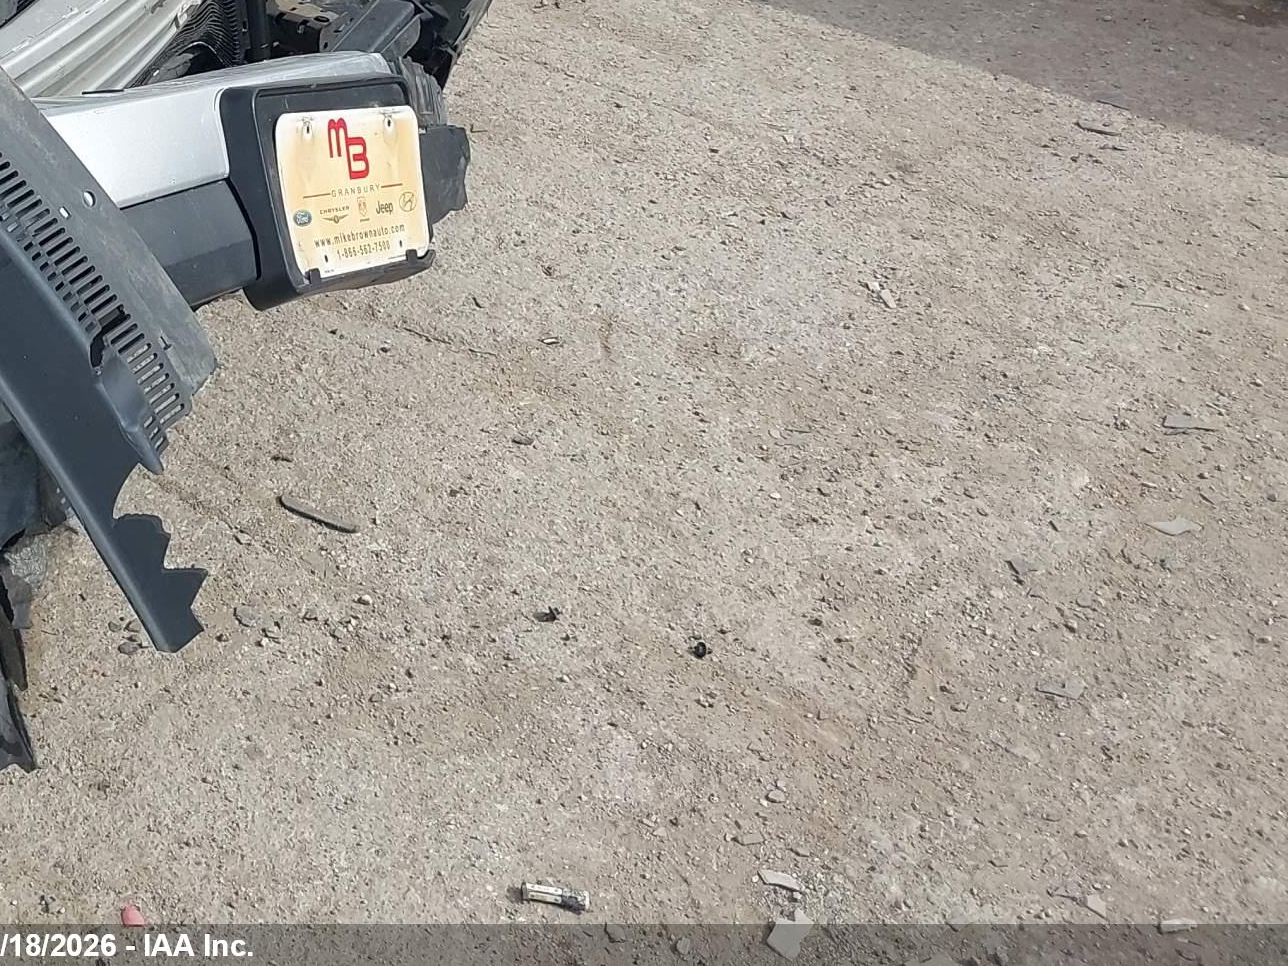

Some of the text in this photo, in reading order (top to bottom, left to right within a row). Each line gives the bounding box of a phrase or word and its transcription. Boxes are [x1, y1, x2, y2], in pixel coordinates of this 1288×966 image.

[331, 183, 381, 197] GRANBURY
[319, 205, 350, 214] CHRYSLER
[375, 201, 394, 214] Jeep
[314, 224, 405, 248] www.mikebrownauto.com
